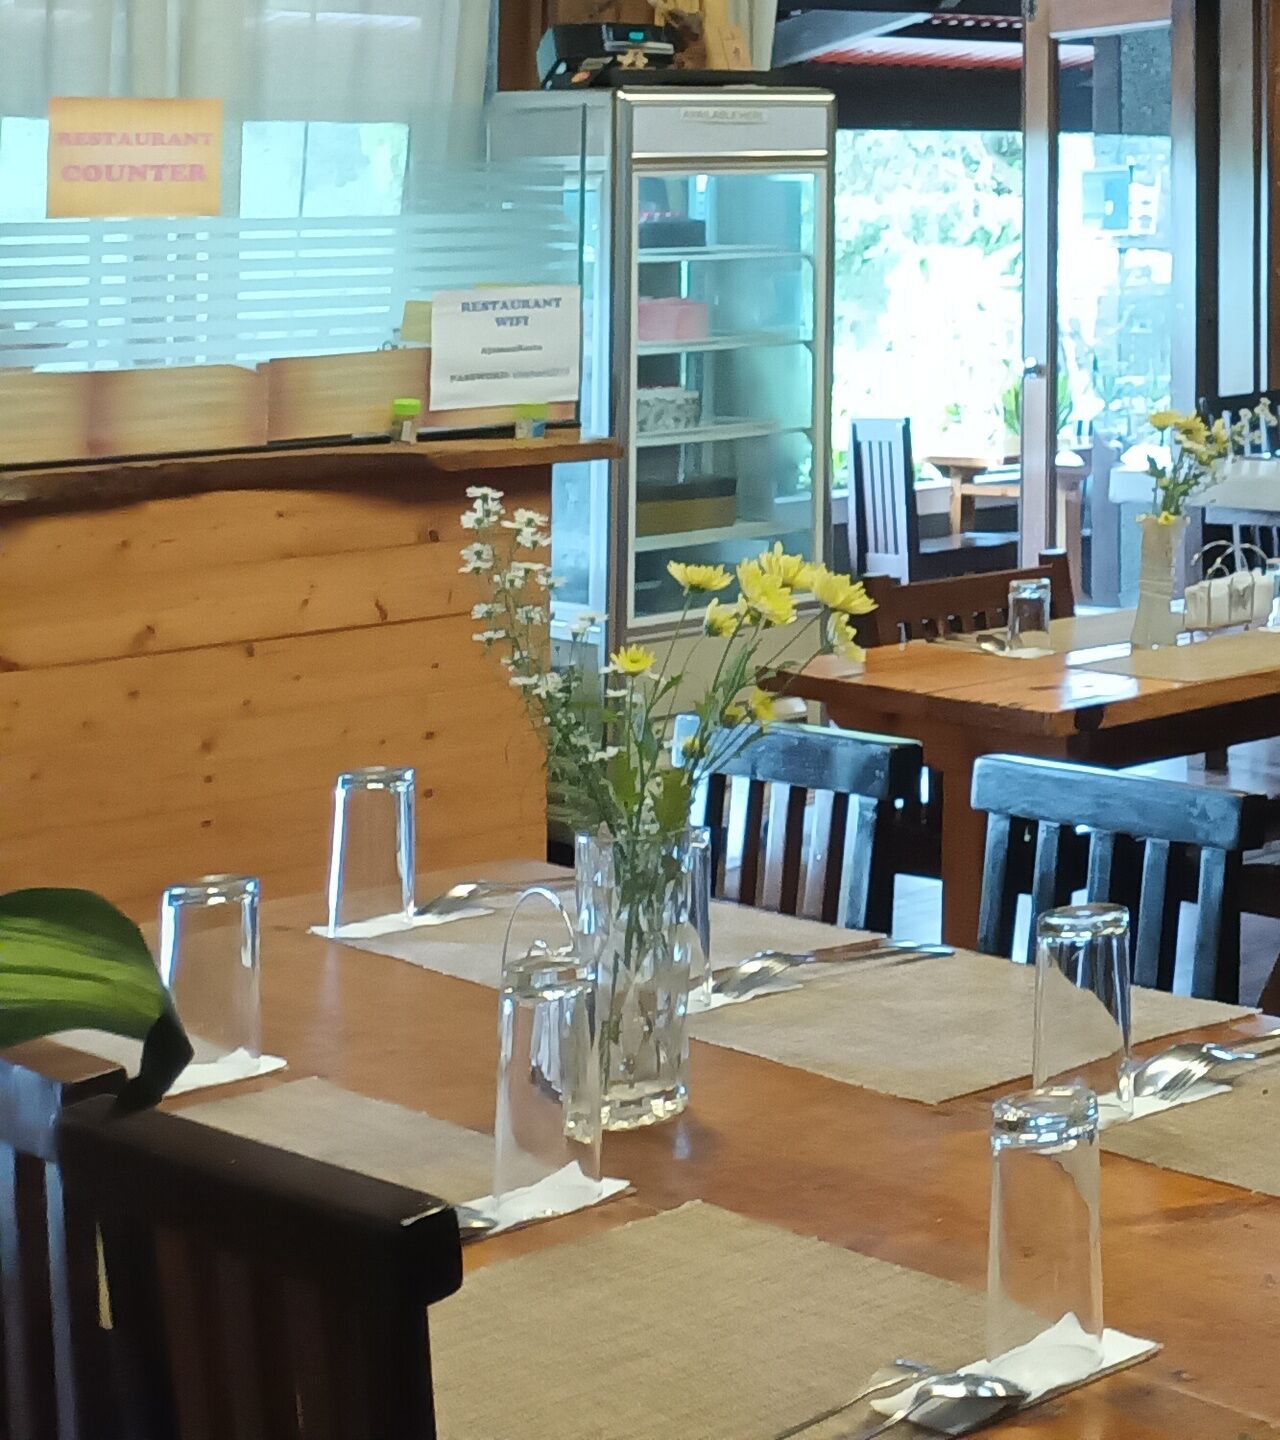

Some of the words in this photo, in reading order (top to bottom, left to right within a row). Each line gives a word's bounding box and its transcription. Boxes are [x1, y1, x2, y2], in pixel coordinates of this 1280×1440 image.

[57, 132, 213, 146] RESTAURANT
[61, 163, 207, 182] COUNTER
[461, 297, 562, 313] RESTAURANT
[495, 315, 529, 327] WIFI
